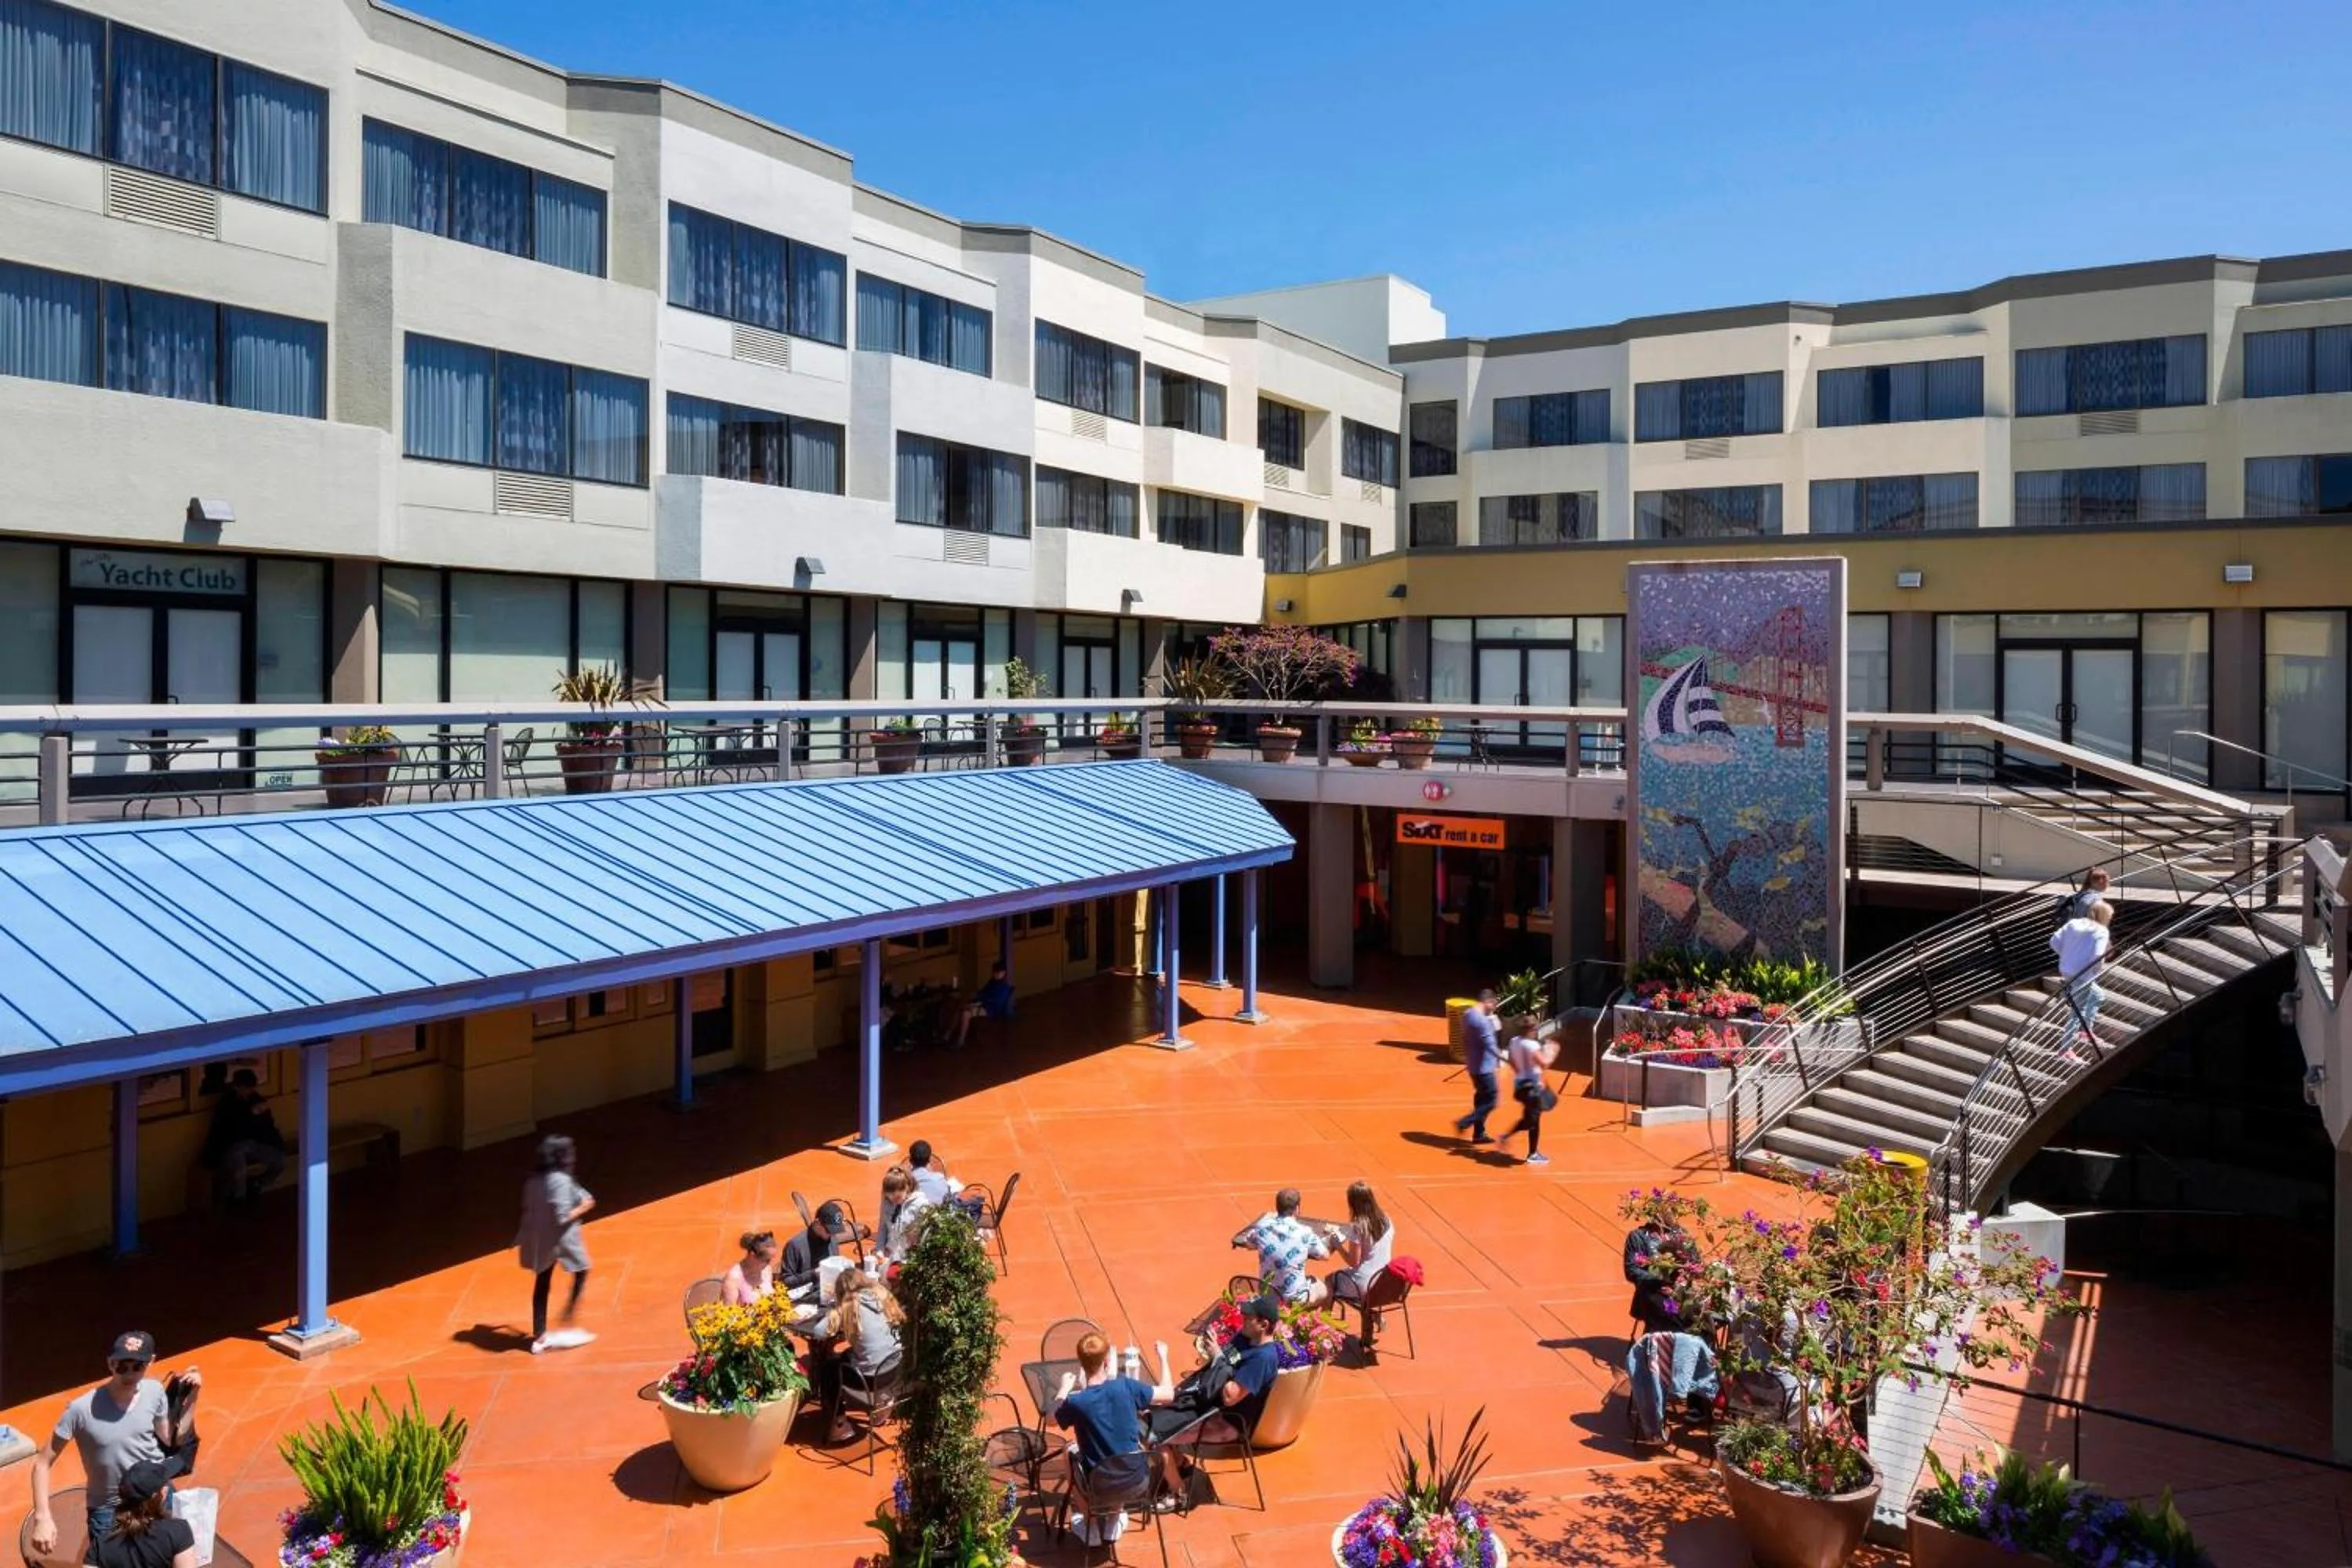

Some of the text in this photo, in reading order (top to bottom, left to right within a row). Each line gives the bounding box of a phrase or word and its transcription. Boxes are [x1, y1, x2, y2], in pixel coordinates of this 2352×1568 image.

[100, 562, 235, 590] Yacht Club
[269, 775, 292, 784] OPEN
[1445, 829, 1467, 842] rent
[1470, 832, 1477, 843] a
[1479, 832, 1499, 844] car
